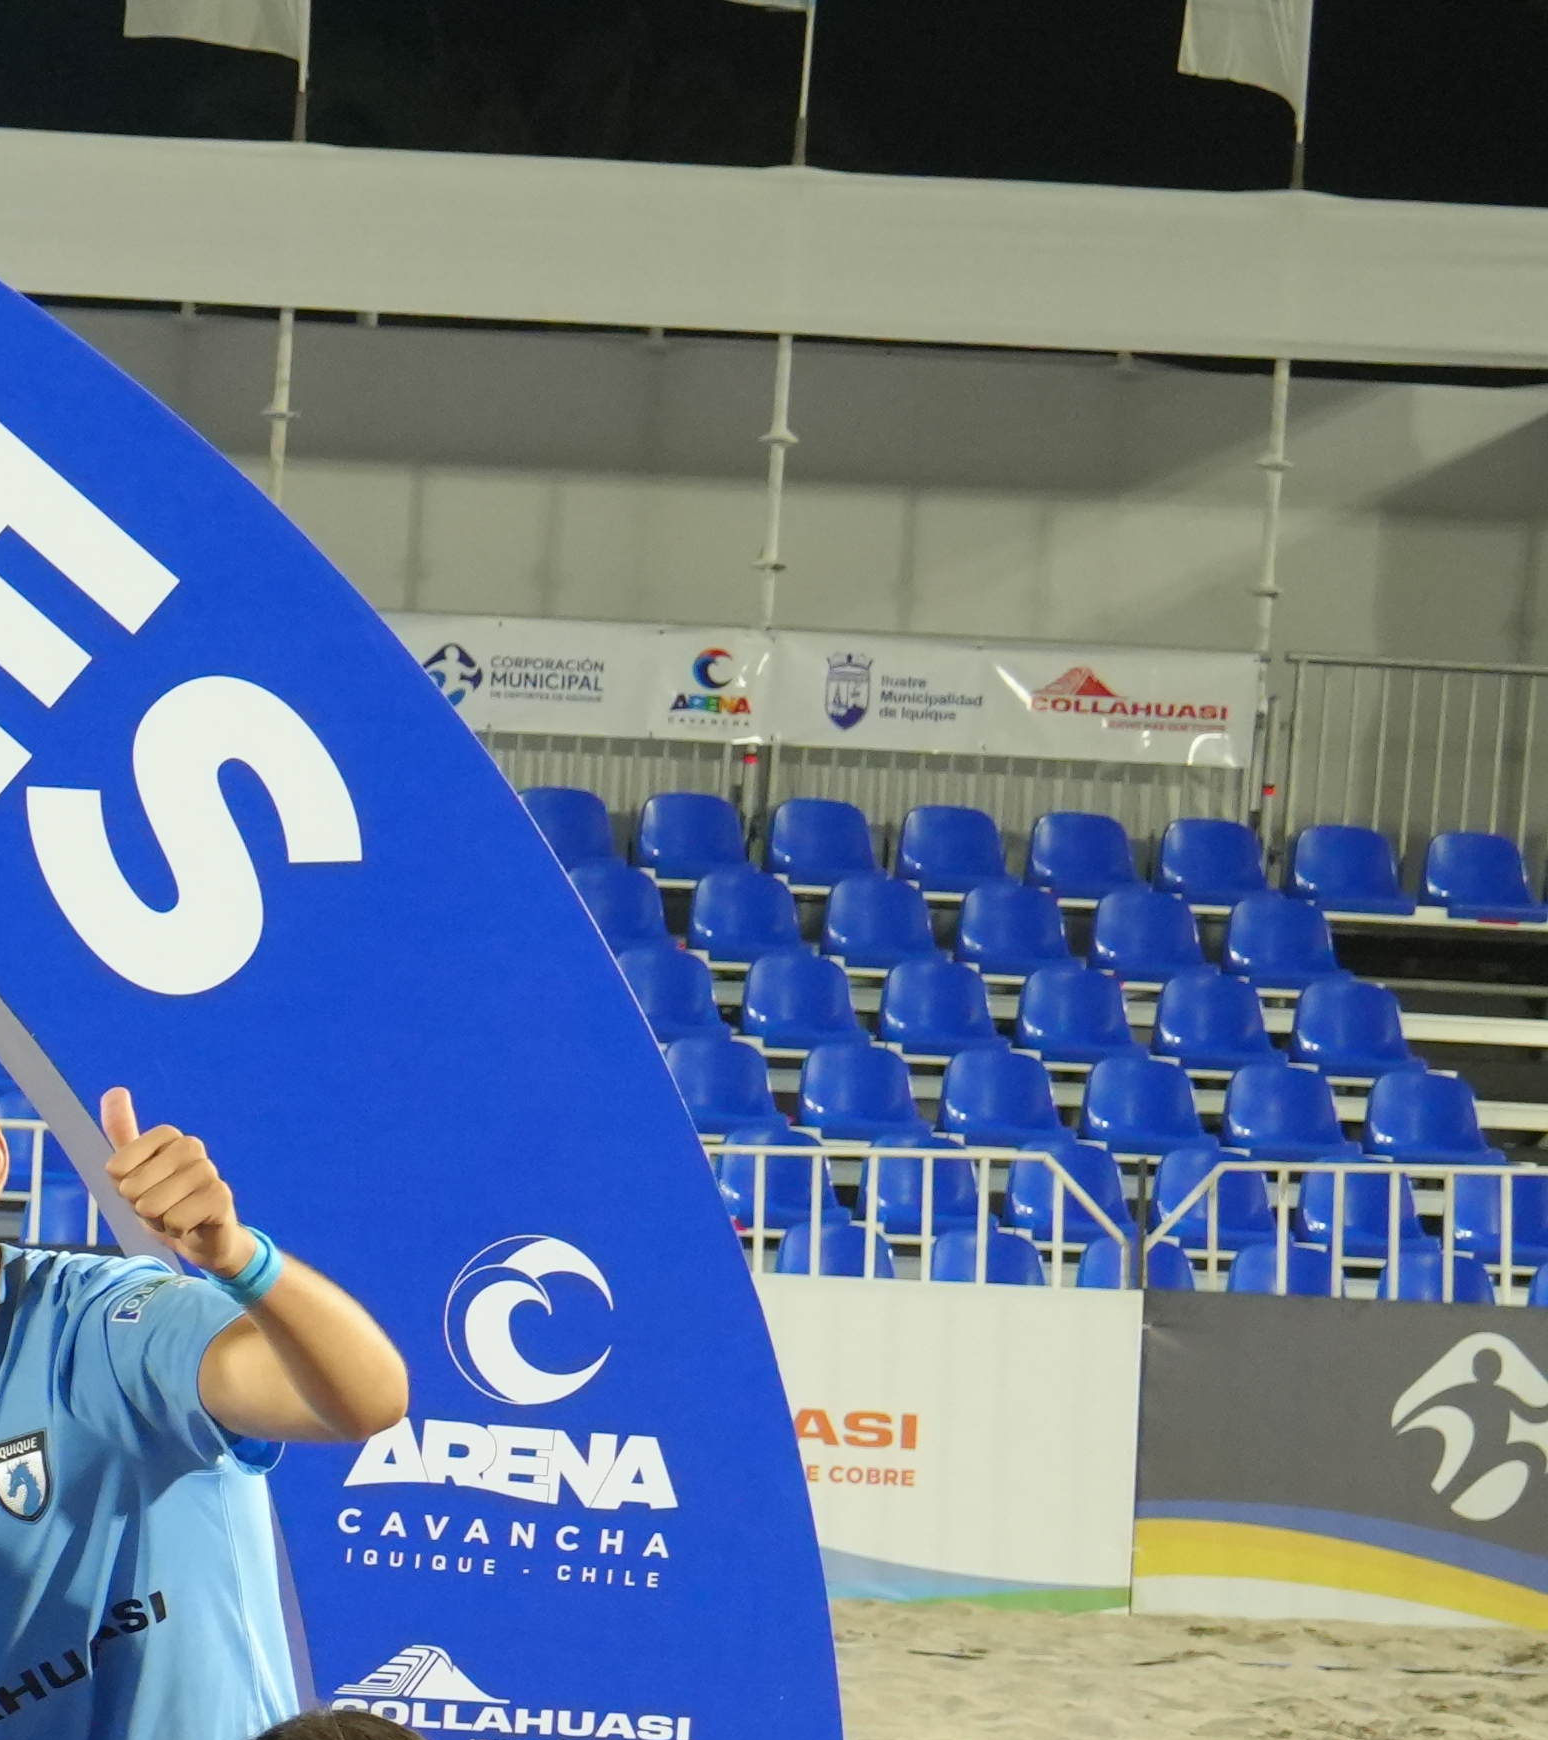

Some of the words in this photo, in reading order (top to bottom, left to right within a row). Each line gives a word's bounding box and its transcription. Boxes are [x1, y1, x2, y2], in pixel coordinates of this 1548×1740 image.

[490, 655, 605, 673] CORPORACIÓN
[490, 672, 604, 692] MUNICIPAL
[670, 694, 751, 716] ARENA
[1031, 693, 1229, 722] COLLAHUASI
[342, 1416, 679, 1511] ARENA
[828, 1465, 917, 1488] COBRE
[337, 1507, 670, 1559] CAVANCHA
[345, 1547, 497, 1576] IQUIQUE
[556, 1564, 660, 1589] CHILE
